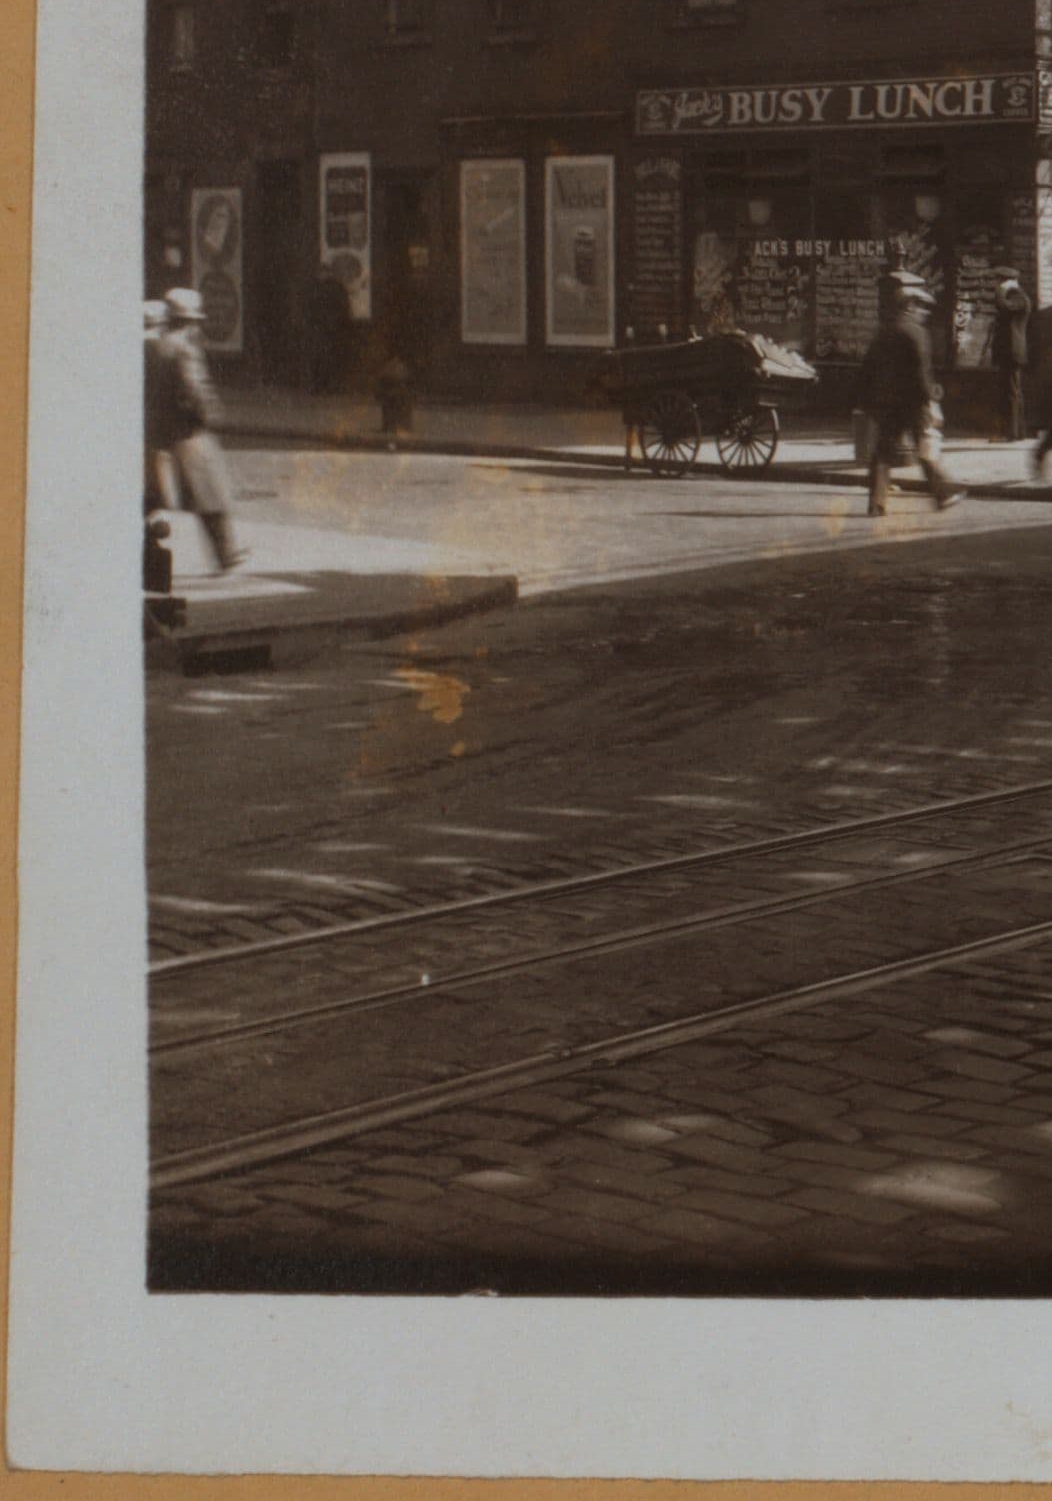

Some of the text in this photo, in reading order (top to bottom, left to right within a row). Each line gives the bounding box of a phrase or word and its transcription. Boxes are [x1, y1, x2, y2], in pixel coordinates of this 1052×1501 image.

[728, 88, 832, 125] BUSY
[847, 79, 996, 121] LUNCH
[795, 239, 831, 256] BUSY
[839, 239, 885, 256] LUNCH
